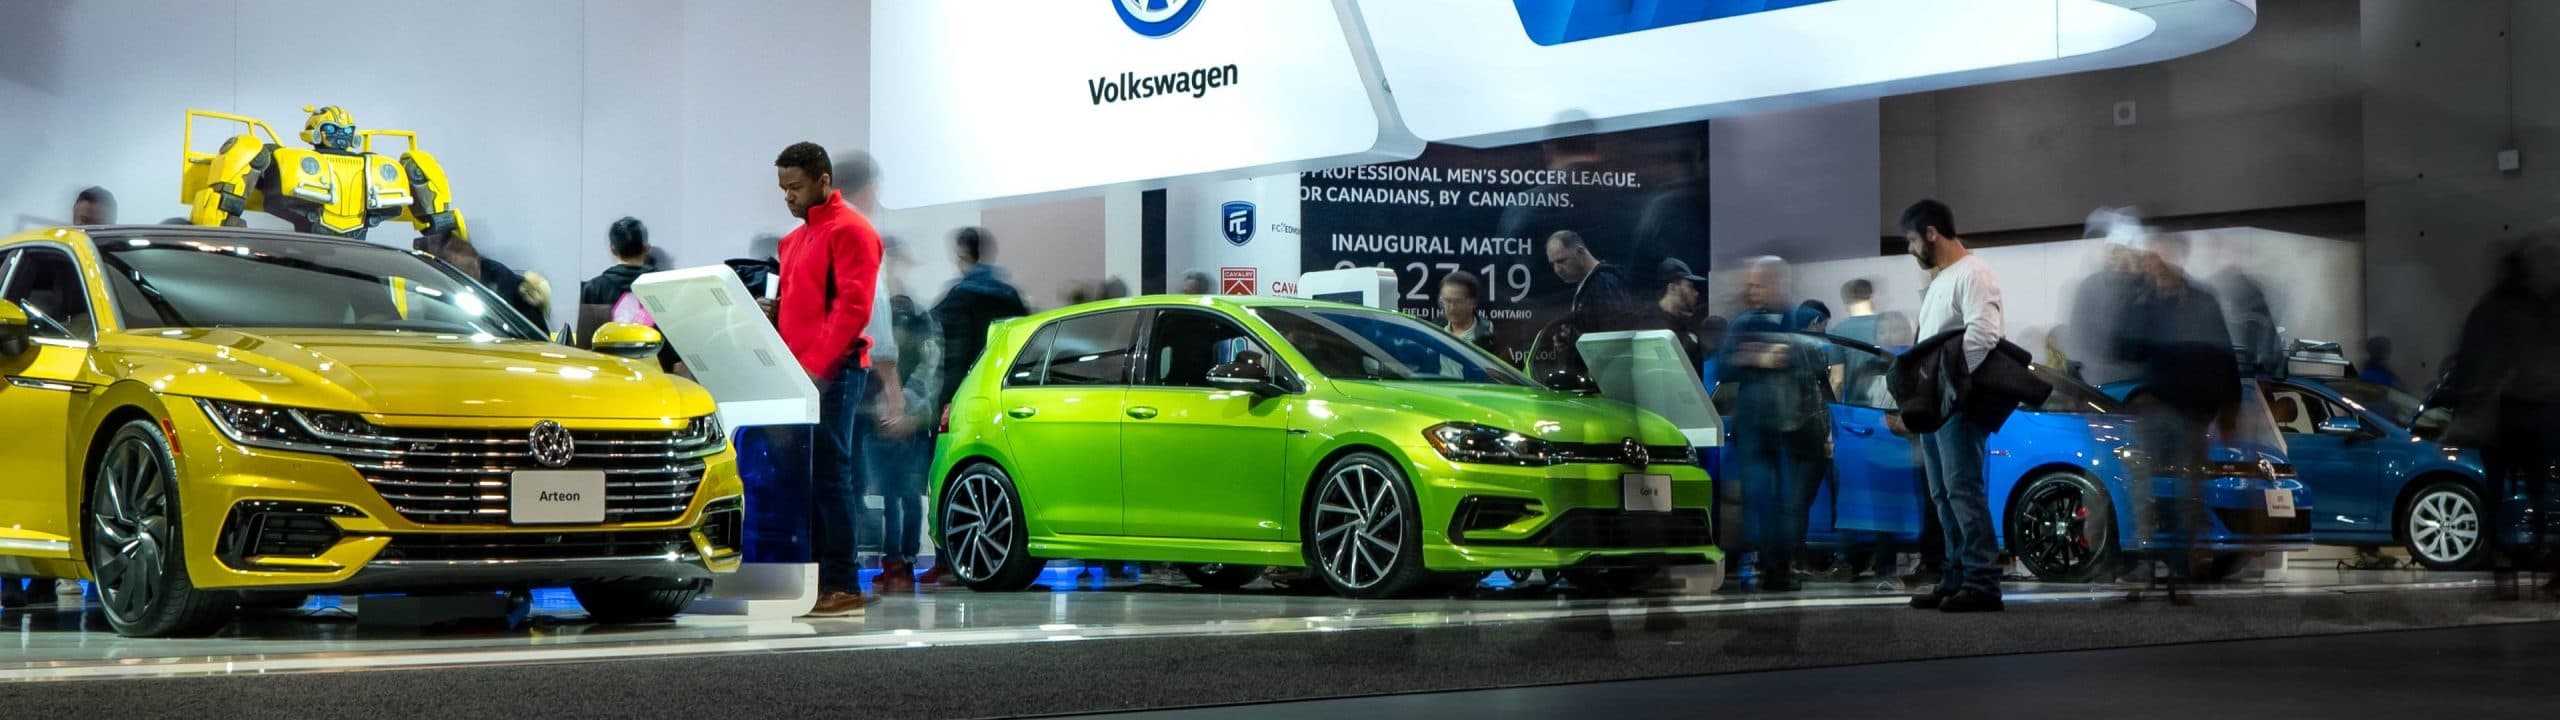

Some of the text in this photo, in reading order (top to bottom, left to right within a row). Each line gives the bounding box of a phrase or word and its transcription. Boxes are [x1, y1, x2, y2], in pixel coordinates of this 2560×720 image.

[1088, 64, 1238, 105] Volkswagen
[1447, 168, 1497, 185] MEN'S
[1500, 169, 1567, 186] SOCCER
[1571, 170, 1641, 188] LEAGUE.
[1326, 186, 1435, 207] CANADIANS,
[1439, 190, 1461, 206] BY
[1468, 191, 1575, 208] CANADIANS.
[1331, 233, 1532, 256] INAUGURAL MATCH
[1490, 309, 1532, 319] ONTARIO
[539, 490, 581, 502] Arteon
